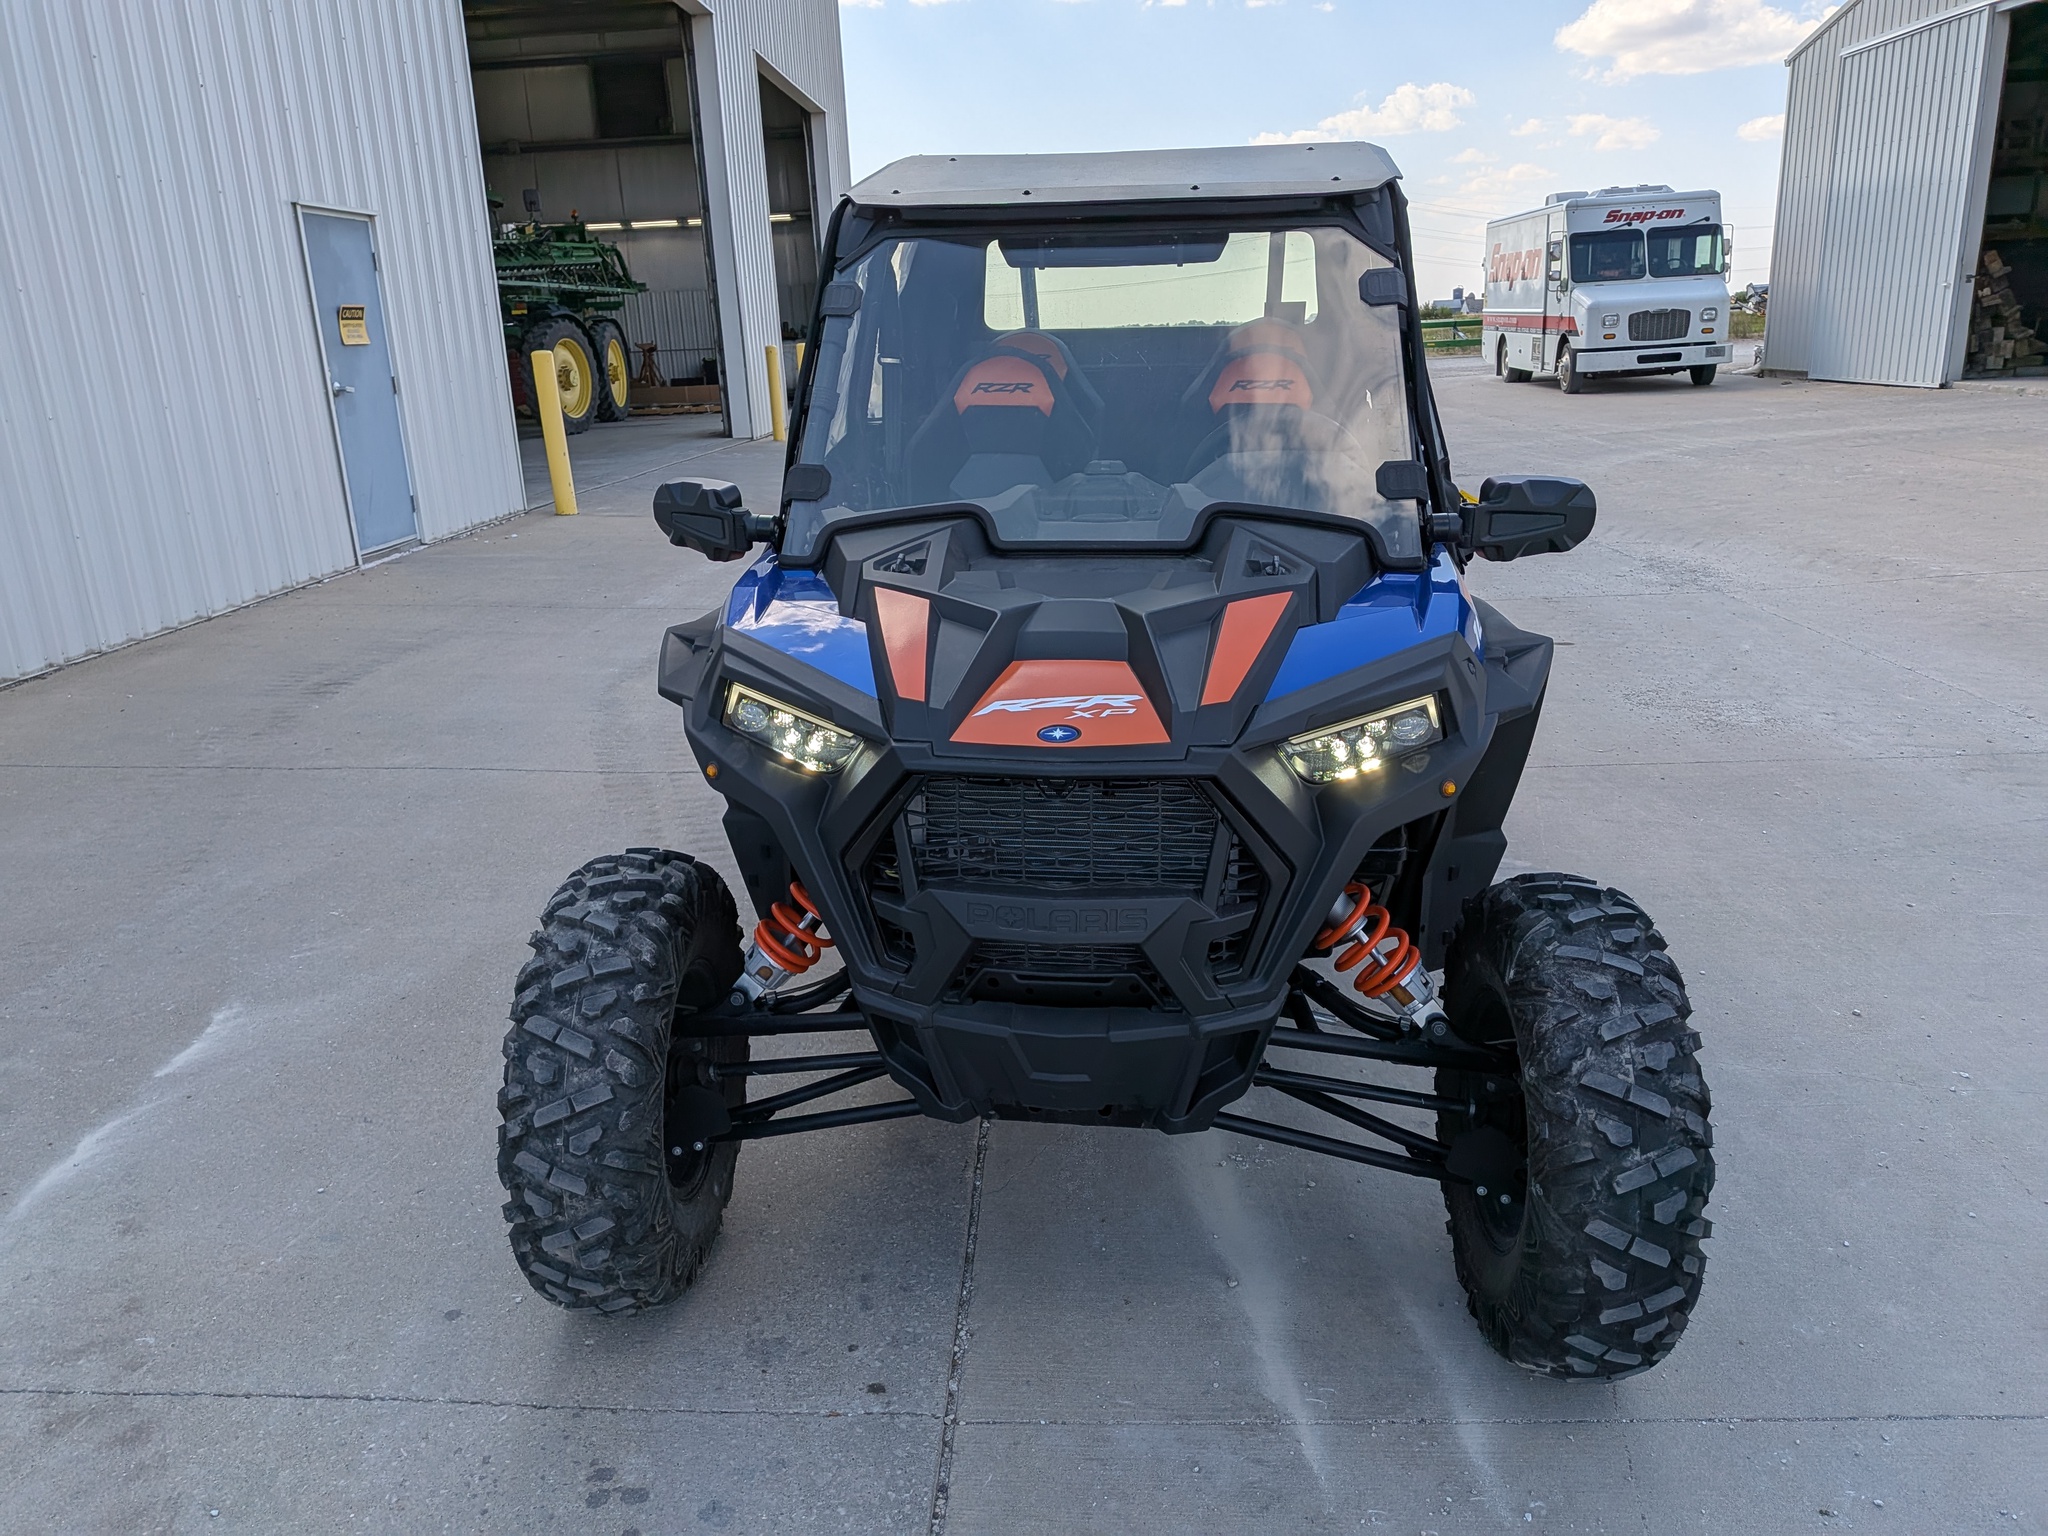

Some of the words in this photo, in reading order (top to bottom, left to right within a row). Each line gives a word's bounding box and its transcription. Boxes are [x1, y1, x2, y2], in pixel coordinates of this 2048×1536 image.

[1603, 209, 1684, 223] Snap-on
[1488, 243, 1543, 291] Snap-on
[342, 309, 363, 318] CAUTION
[970, 382, 1034, 395] RZR
[1228, 379, 1295, 393] RZR
[971, 694, 1144, 717] RZR
[1063, 707, 1137, 719] XP
[966, 902, 1148, 933] POLARIS
